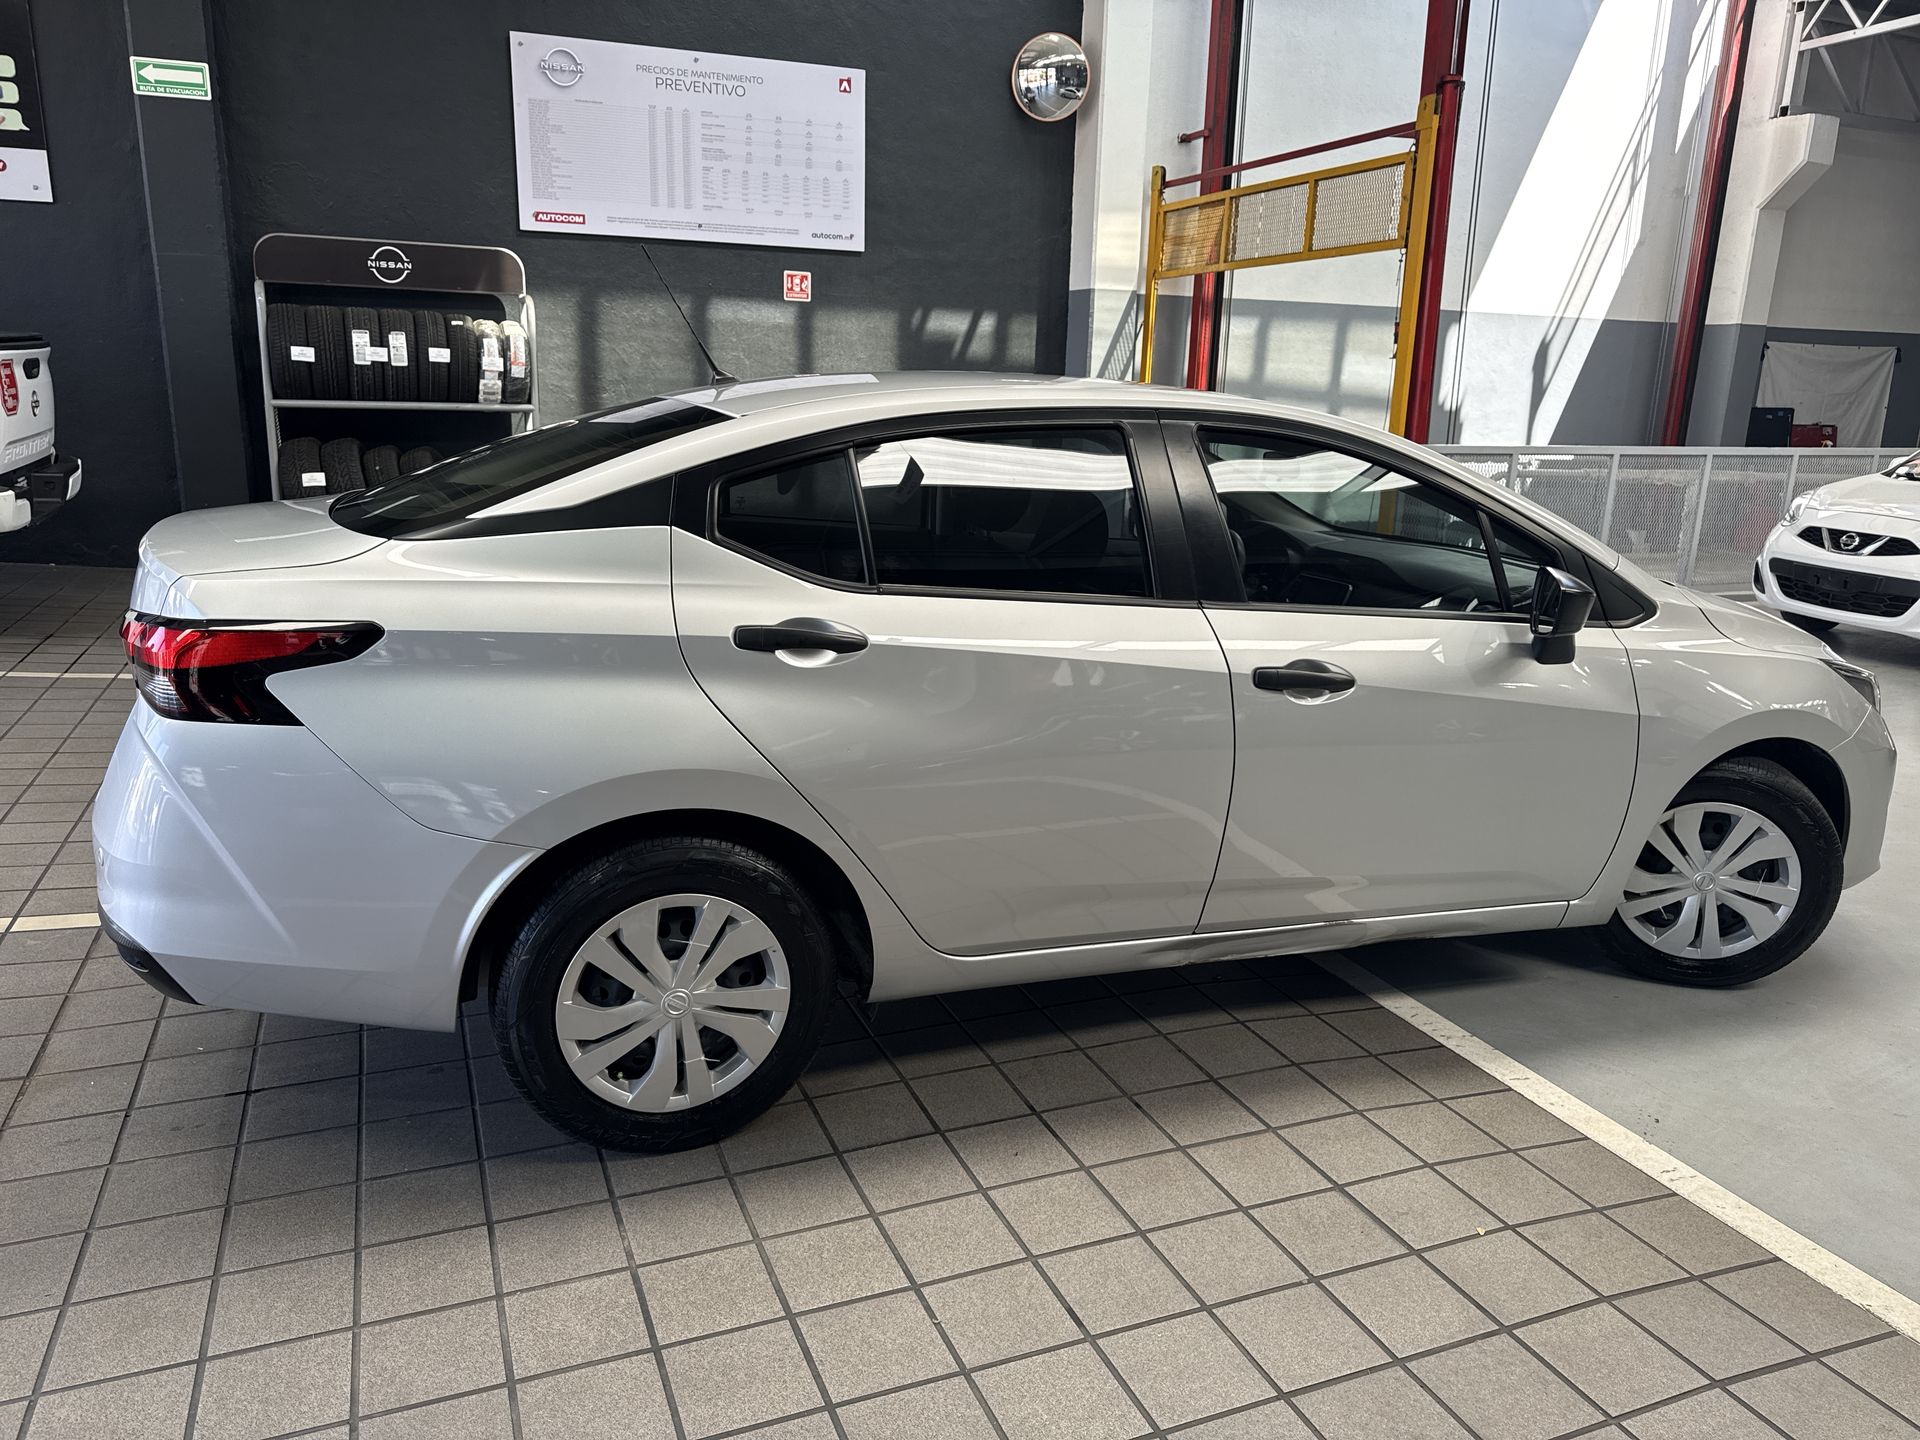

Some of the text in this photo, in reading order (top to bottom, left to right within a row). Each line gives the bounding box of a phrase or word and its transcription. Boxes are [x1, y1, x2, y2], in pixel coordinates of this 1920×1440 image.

[541, 61, 585, 72] NISSAN
[635, 64, 764, 85] PRECIOS DE MANTENIMIENTO
[655, 77, 746, 98] PREVENTIVO
[536, 213, 584, 223] AUTOCOM
[367, 260, 412, 269] NISSAN
